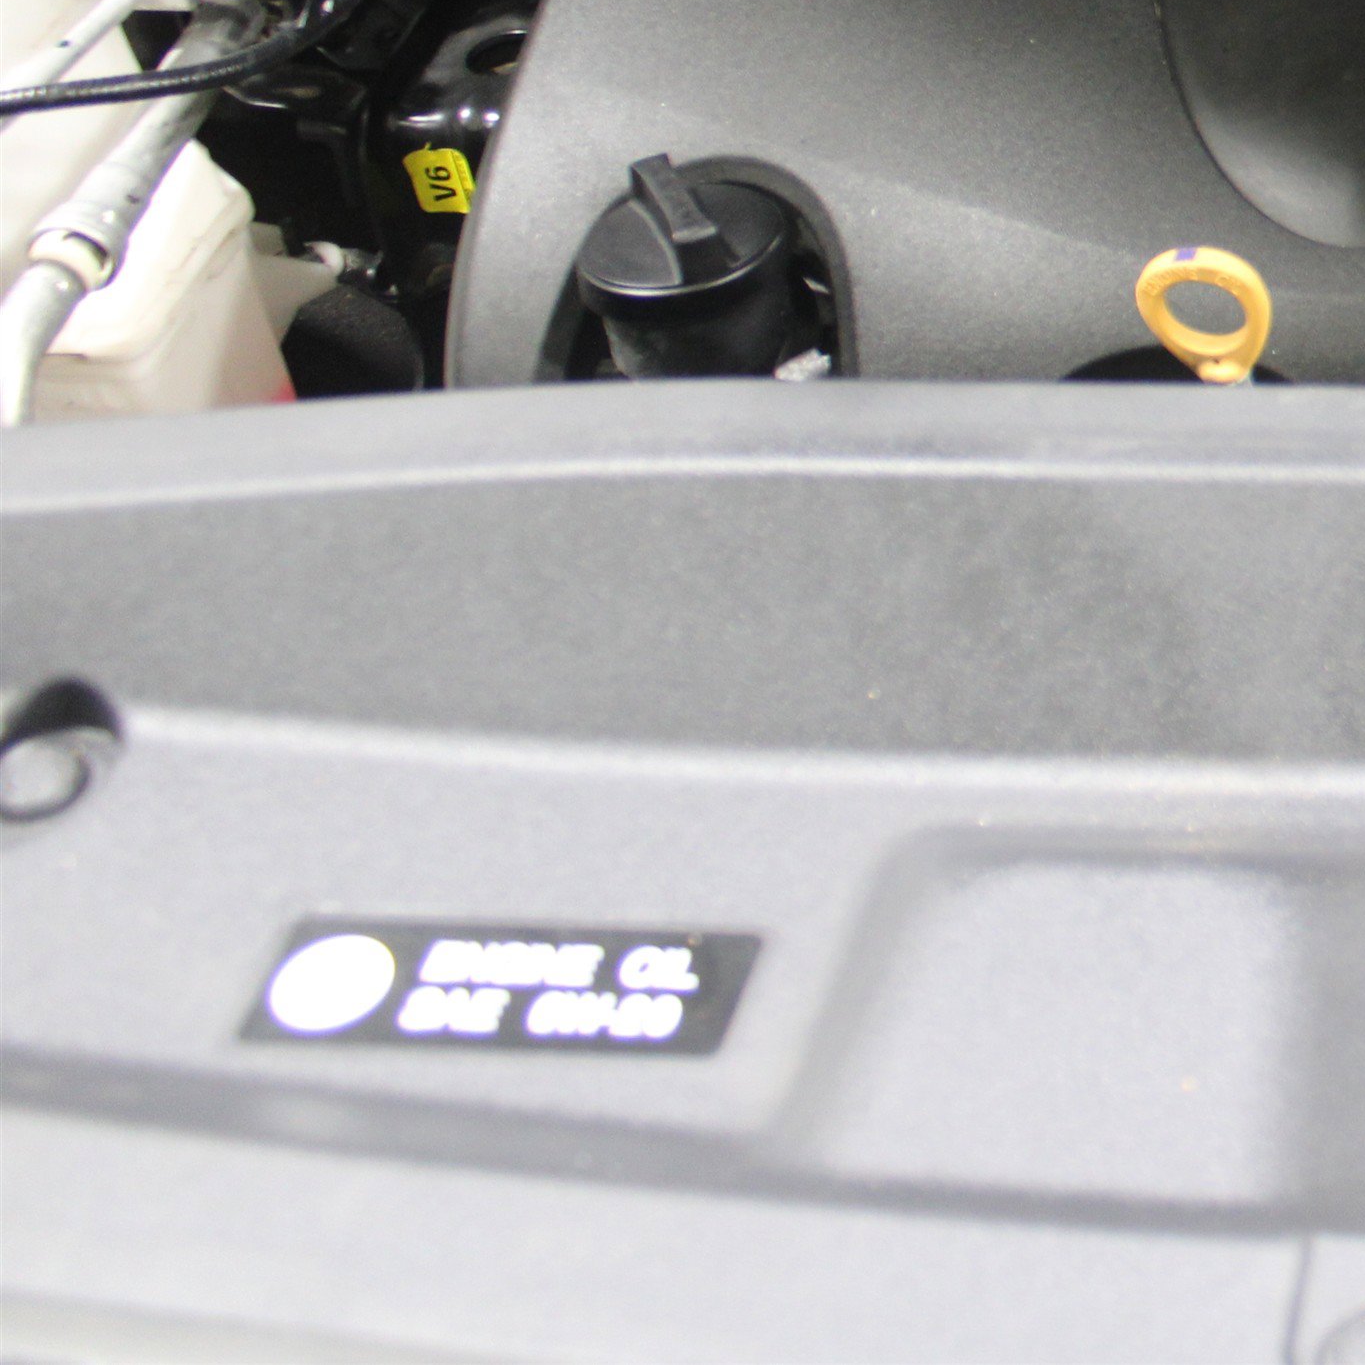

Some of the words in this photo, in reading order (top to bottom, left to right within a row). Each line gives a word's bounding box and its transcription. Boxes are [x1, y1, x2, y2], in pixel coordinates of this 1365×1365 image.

[424, 165, 457, 202] V6
[418, 938, 605, 989] ENGINE
[616, 945, 700, 992] OIL
[395, 986, 510, 1034] SAE
